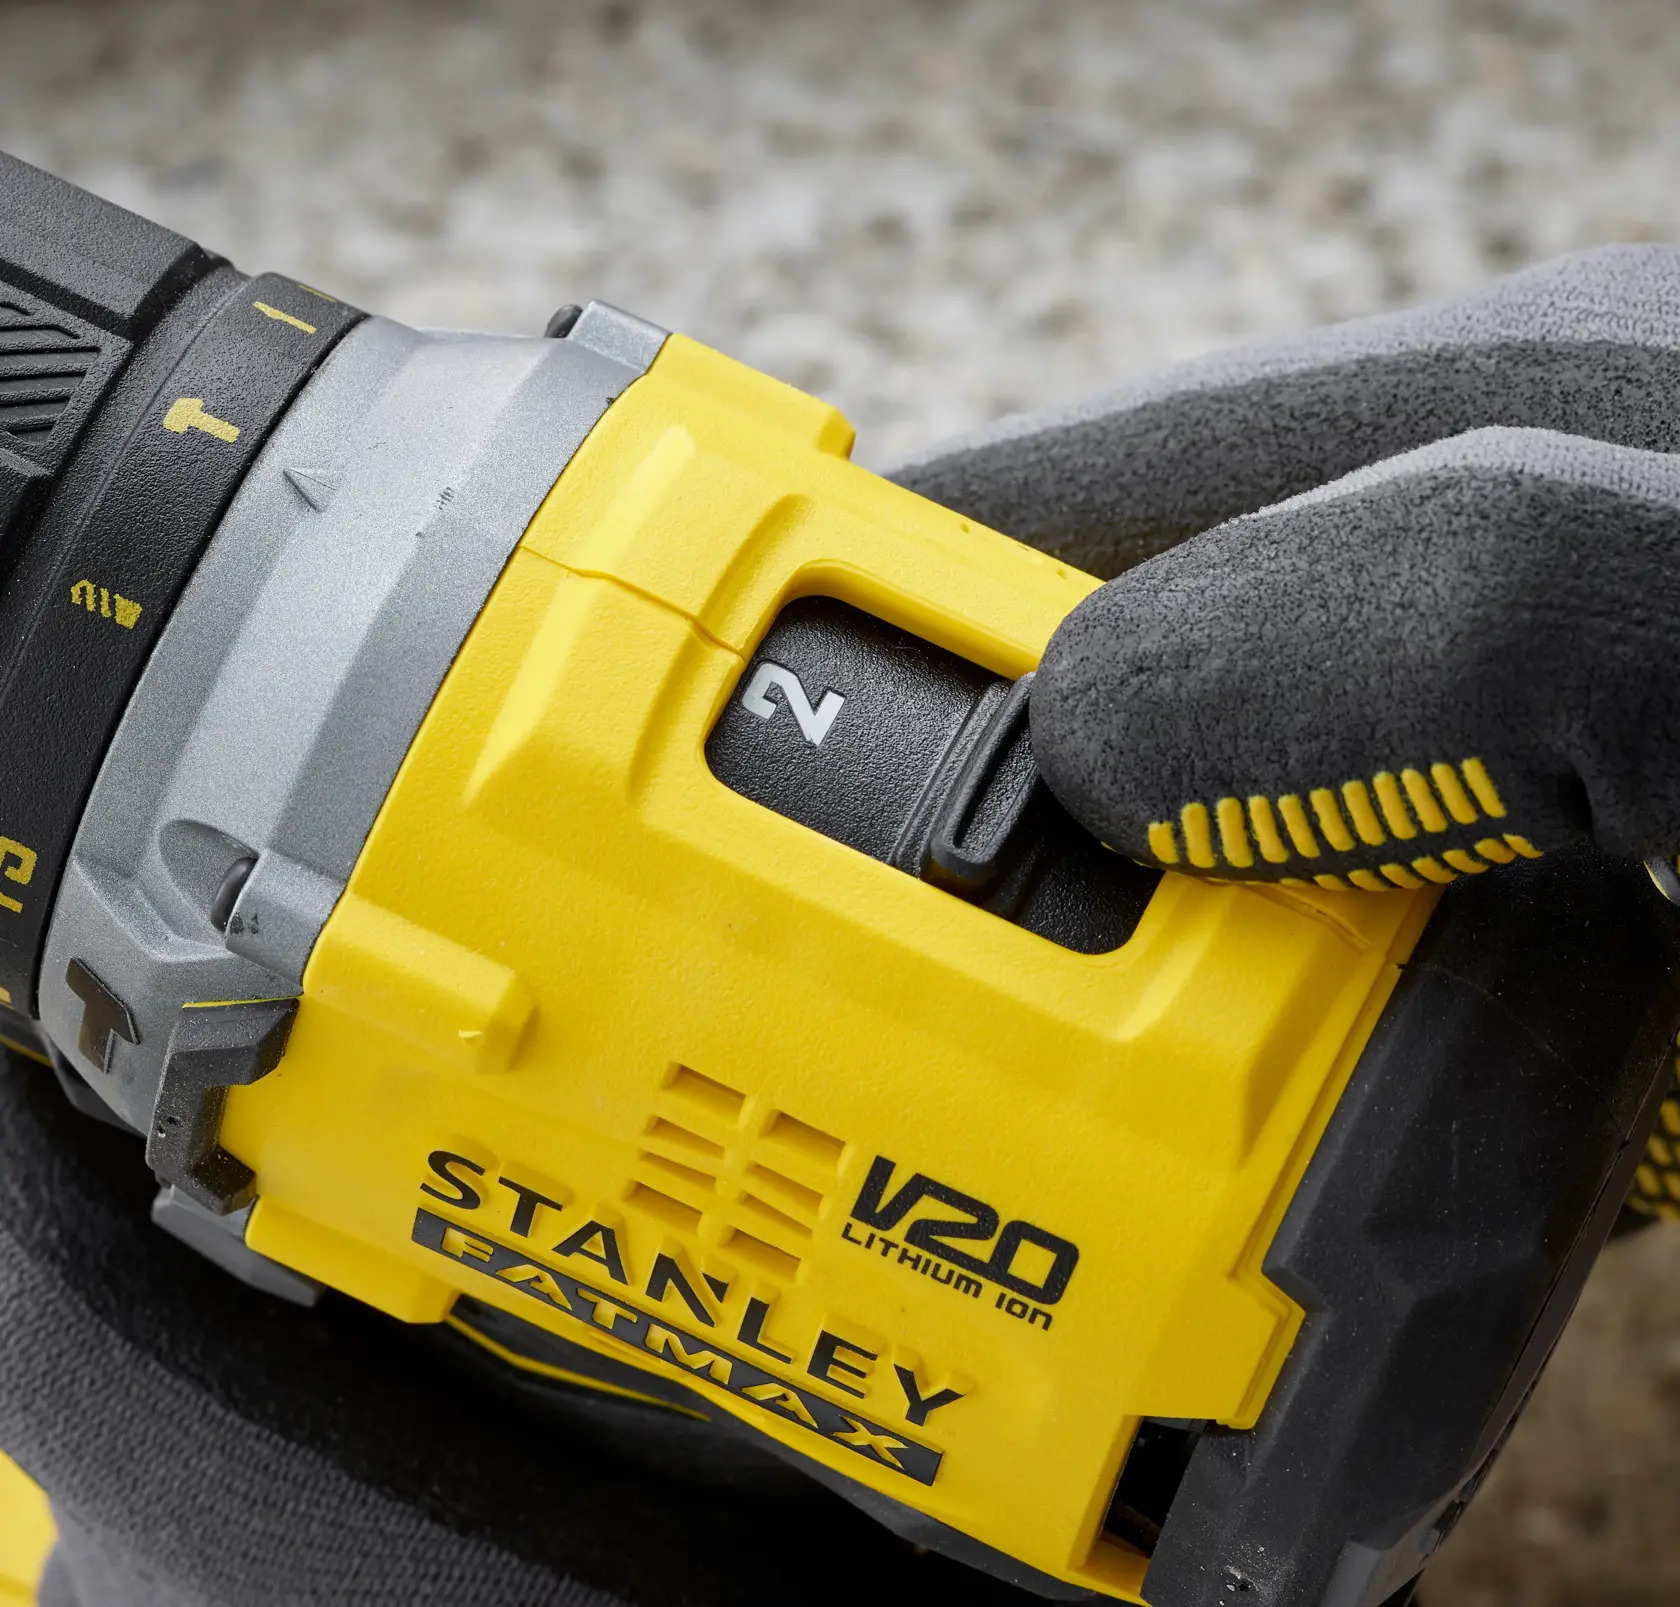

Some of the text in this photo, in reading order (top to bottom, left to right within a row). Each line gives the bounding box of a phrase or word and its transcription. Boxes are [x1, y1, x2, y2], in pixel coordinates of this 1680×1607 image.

[741, 662, 847, 747] 2
[418, 1149, 966, 1428] STANLEY
[841, 1222, 984, 1299] LITHIUM
[850, 1154, 1080, 1306] V20
[440, 1226, 911, 1471] FATMAX
